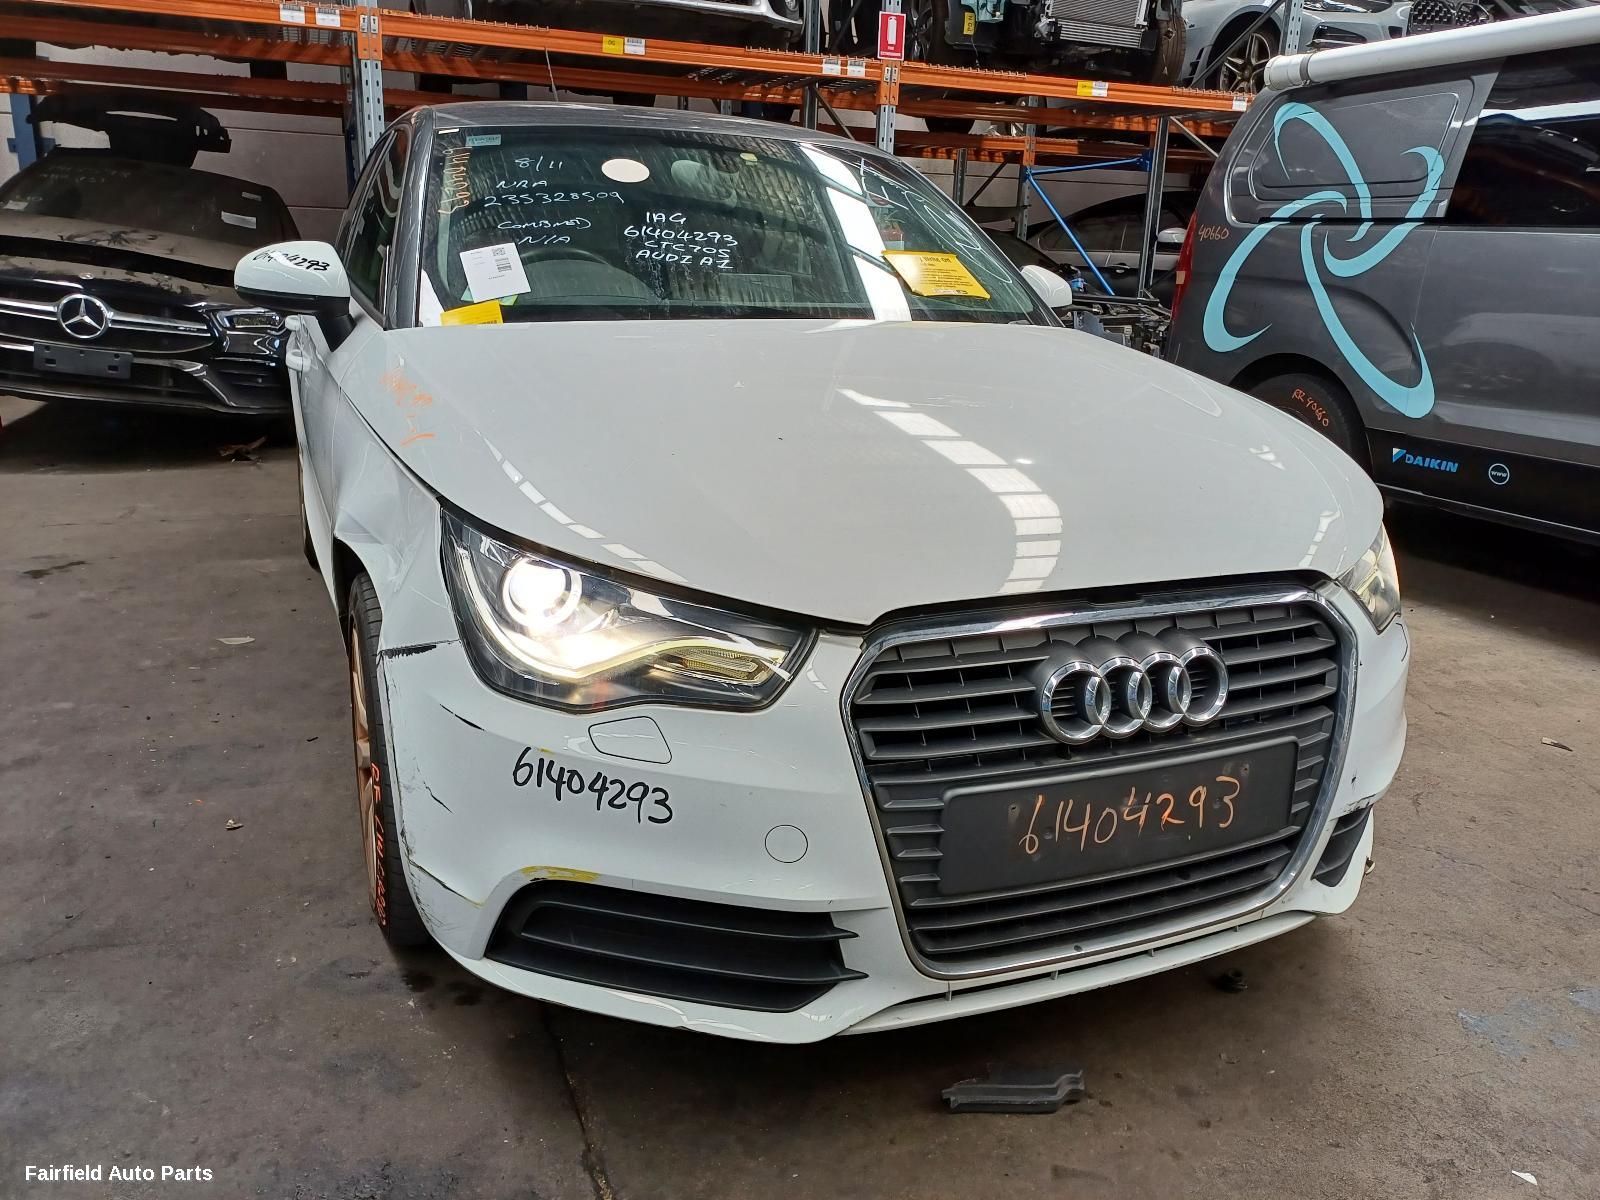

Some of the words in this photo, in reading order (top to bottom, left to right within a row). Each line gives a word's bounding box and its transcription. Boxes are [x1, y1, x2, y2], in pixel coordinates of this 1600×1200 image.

[623, 225, 739, 247] 61404293
[1198, 224, 1229, 241] 40660
[635, 249, 693, 264] AUDI
[1405, 453, 1461, 473] DAIKIN
[512, 746, 674, 824] 61404293
[1018, 775, 1241, 855] 61404293
